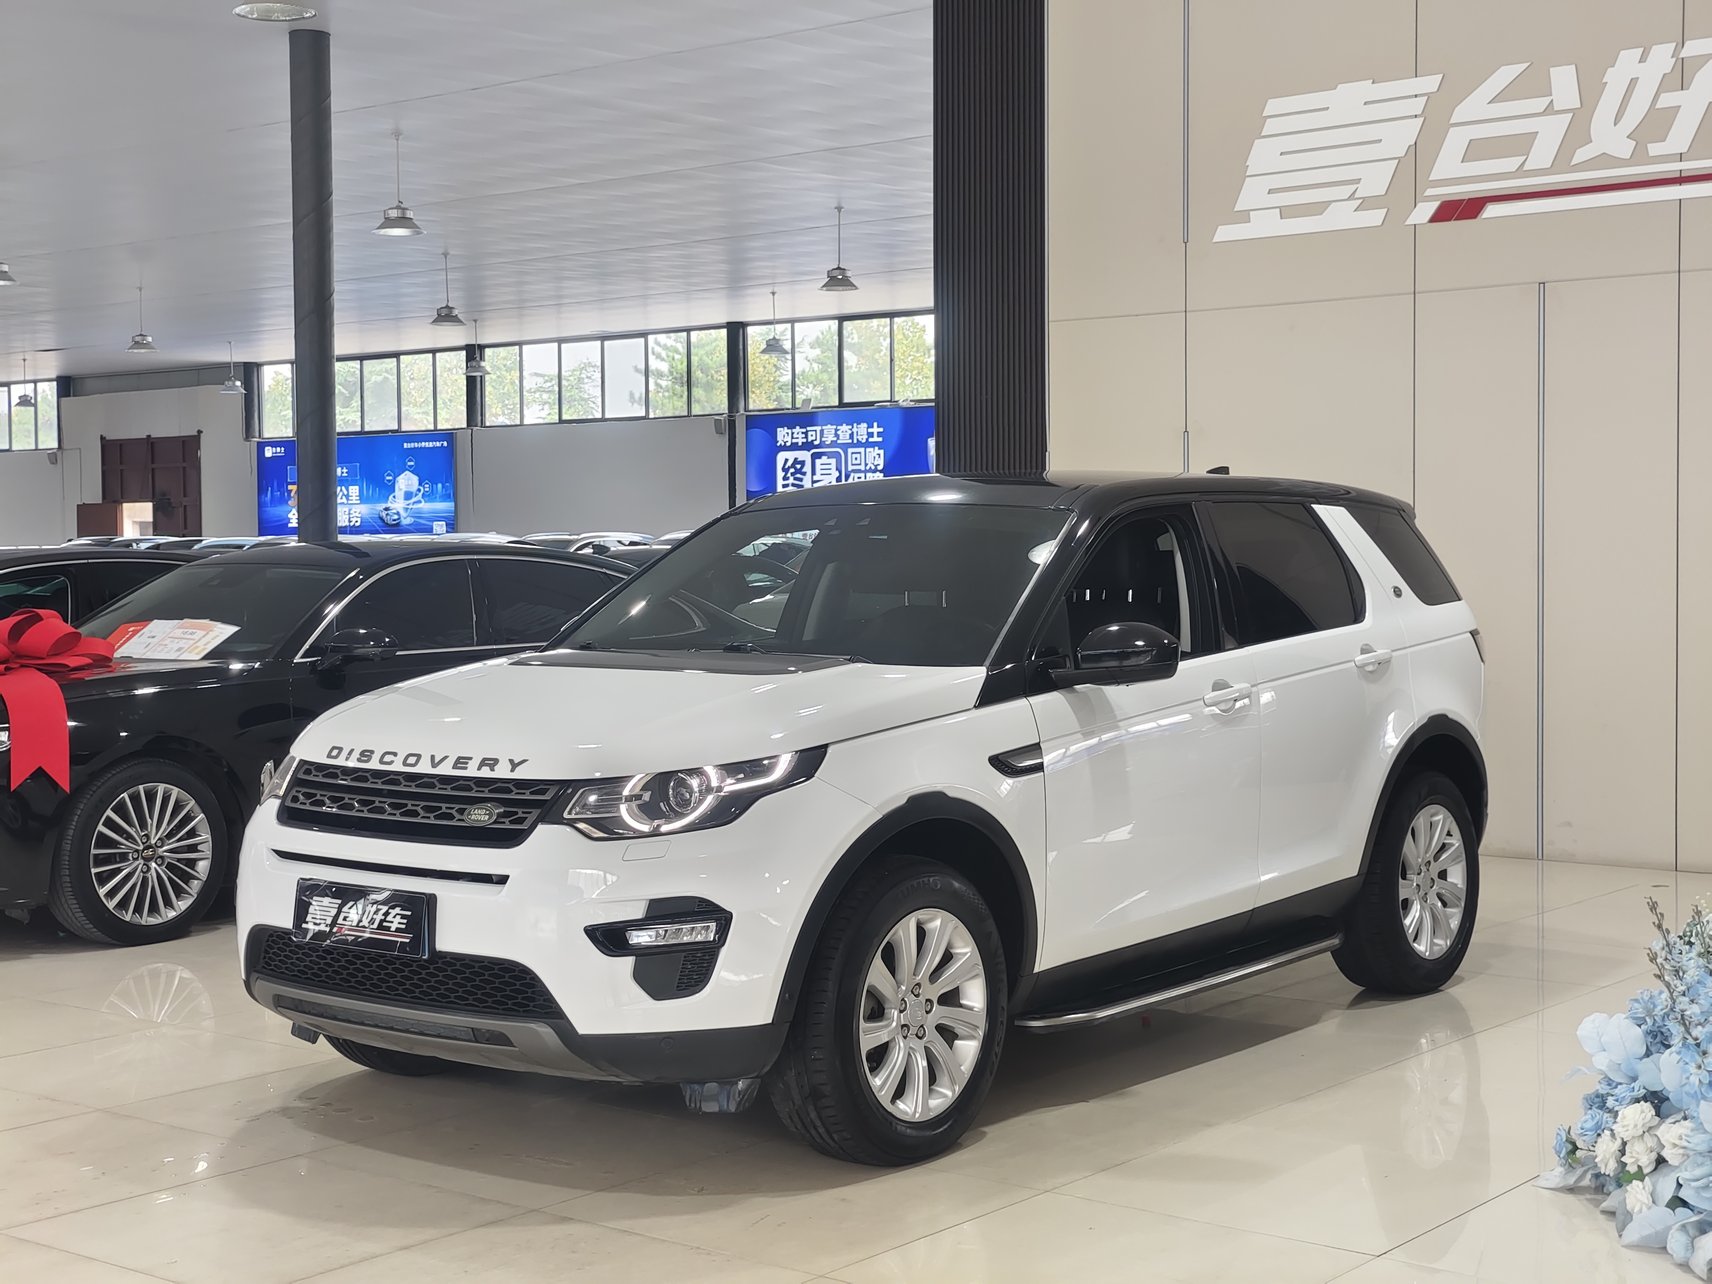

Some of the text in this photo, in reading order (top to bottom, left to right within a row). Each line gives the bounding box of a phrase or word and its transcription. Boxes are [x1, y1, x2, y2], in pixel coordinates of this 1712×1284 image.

[1212, 37, 1712, 243] 壹台好
[776, 422, 884, 446] 购车可享查博士
[847, 446, 884, 471] 回购
[782, 457, 840, 488] 终身
[336, 486, 360, 505] 公里
[337, 507, 361, 526] 服务
[326, 745, 529, 773] DISCOVERY
[897, 876, 942, 897] UMHO
[301, 896, 412, 933] 壹台好车
